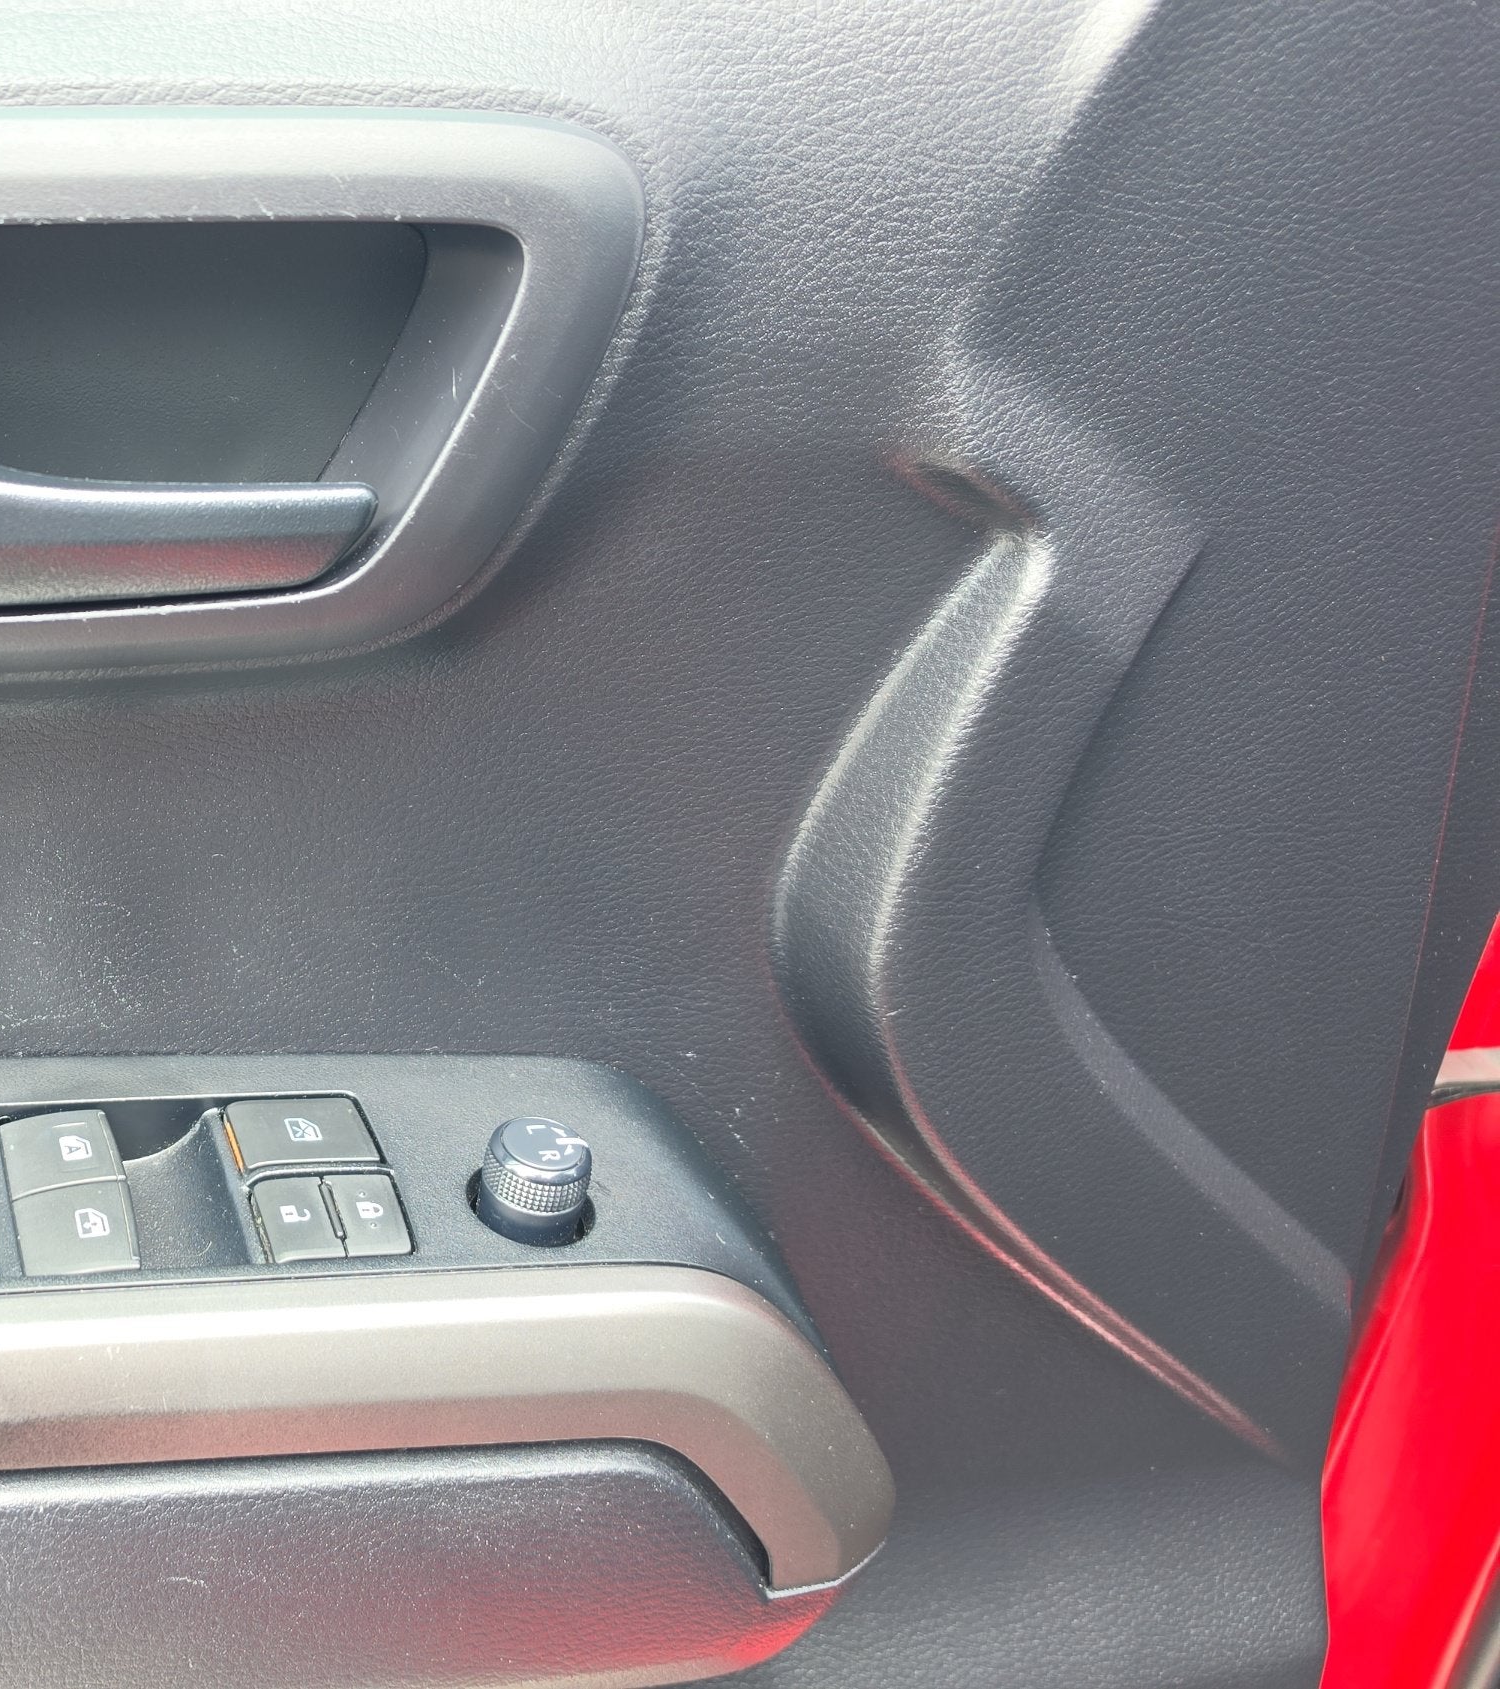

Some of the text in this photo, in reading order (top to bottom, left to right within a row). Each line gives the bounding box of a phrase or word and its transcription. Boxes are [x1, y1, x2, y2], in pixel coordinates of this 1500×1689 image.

[525, 1124, 547, 1135] L
[63, 1145, 82, 1156] A
[538, 1150, 561, 1162] R
